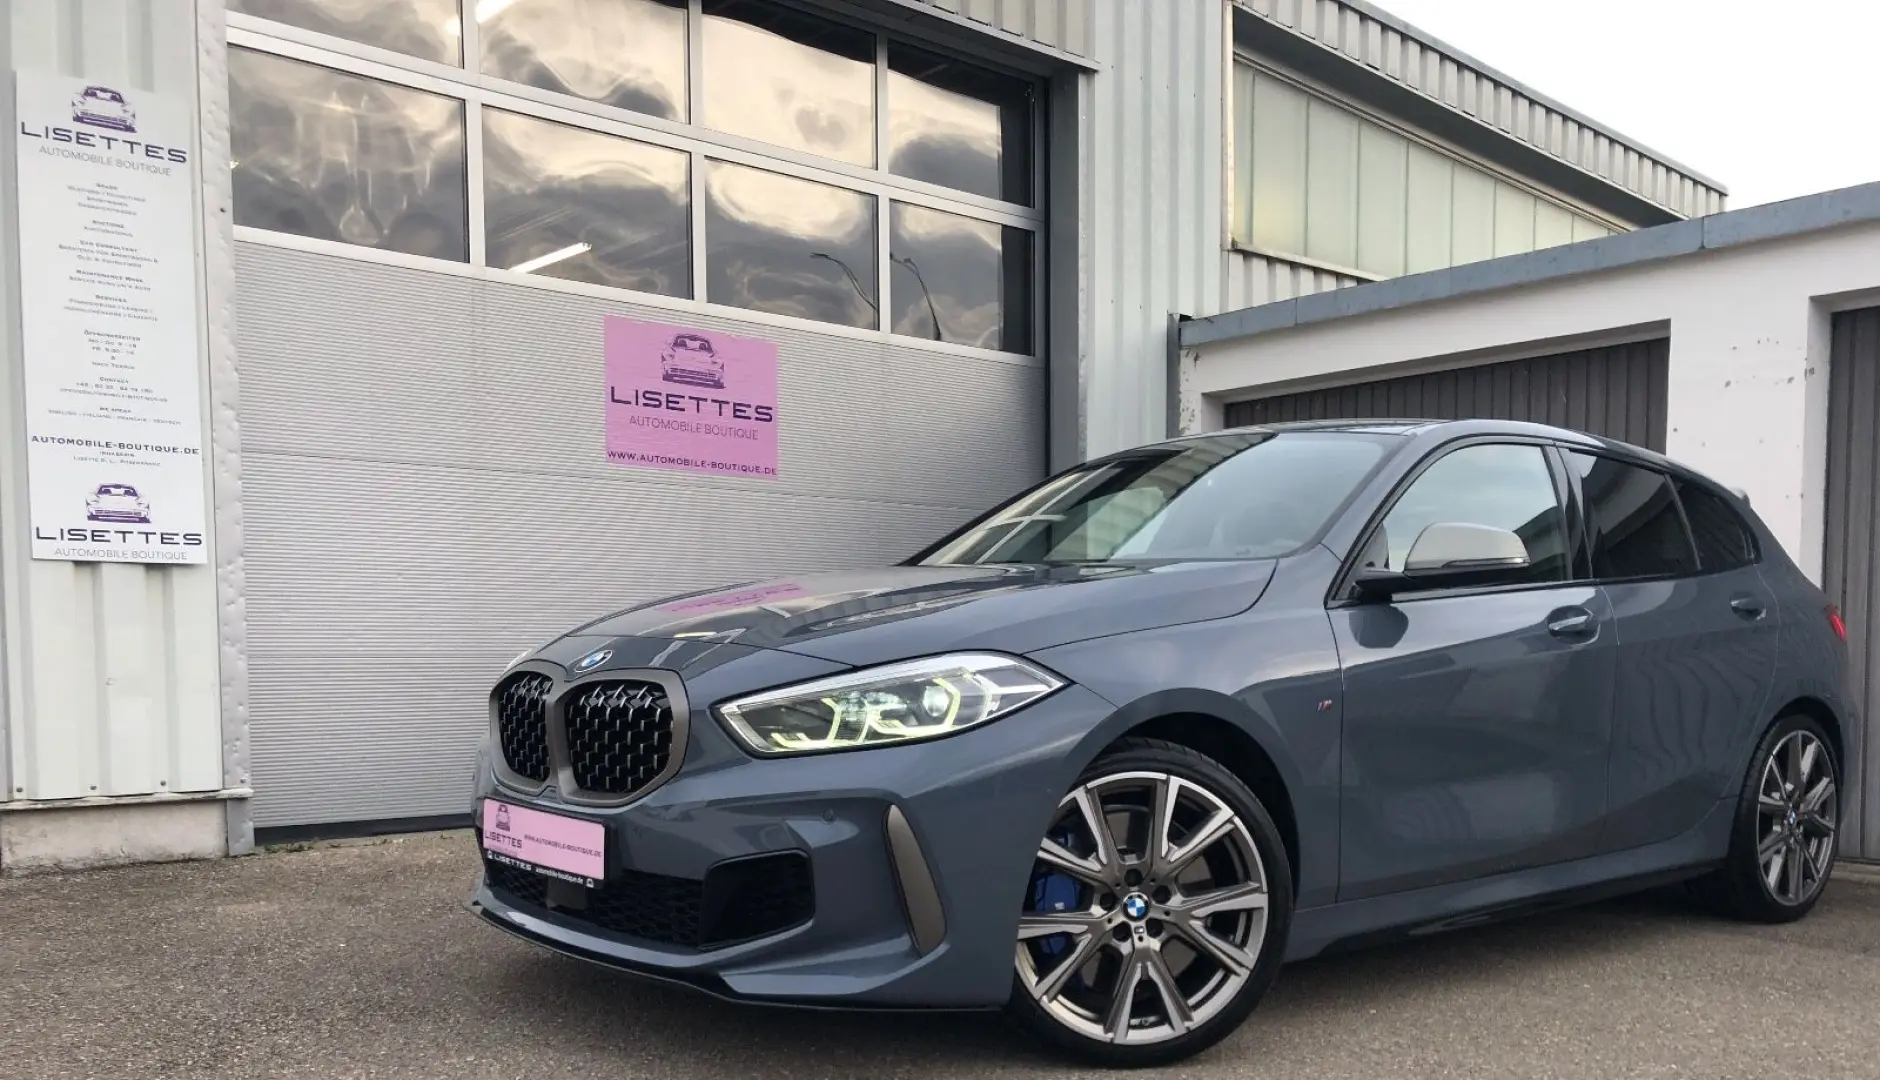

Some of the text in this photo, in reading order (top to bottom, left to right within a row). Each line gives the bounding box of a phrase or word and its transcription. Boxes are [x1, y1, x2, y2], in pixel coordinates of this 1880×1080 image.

[20, 121, 188, 164] LISETTES
[38, 145, 172, 176] AUTOMOBILE BOUTIQUE
[610, 386, 774, 423] LISETTES
[629, 415, 759, 440] AUTOMOBILE BOUTIQUE
[30, 435, 200, 456] AUTOMOBILE-BOUTIQUE.DE
[607, 450, 777, 476] WWW.AUTOMOBILE-BOUTIQUE.DE
[36, 526, 203, 546] LISETTES
[54, 547, 188, 561] AUTOMOBILE BOUTIQUE
[484, 830, 523, 848] LISETTES
